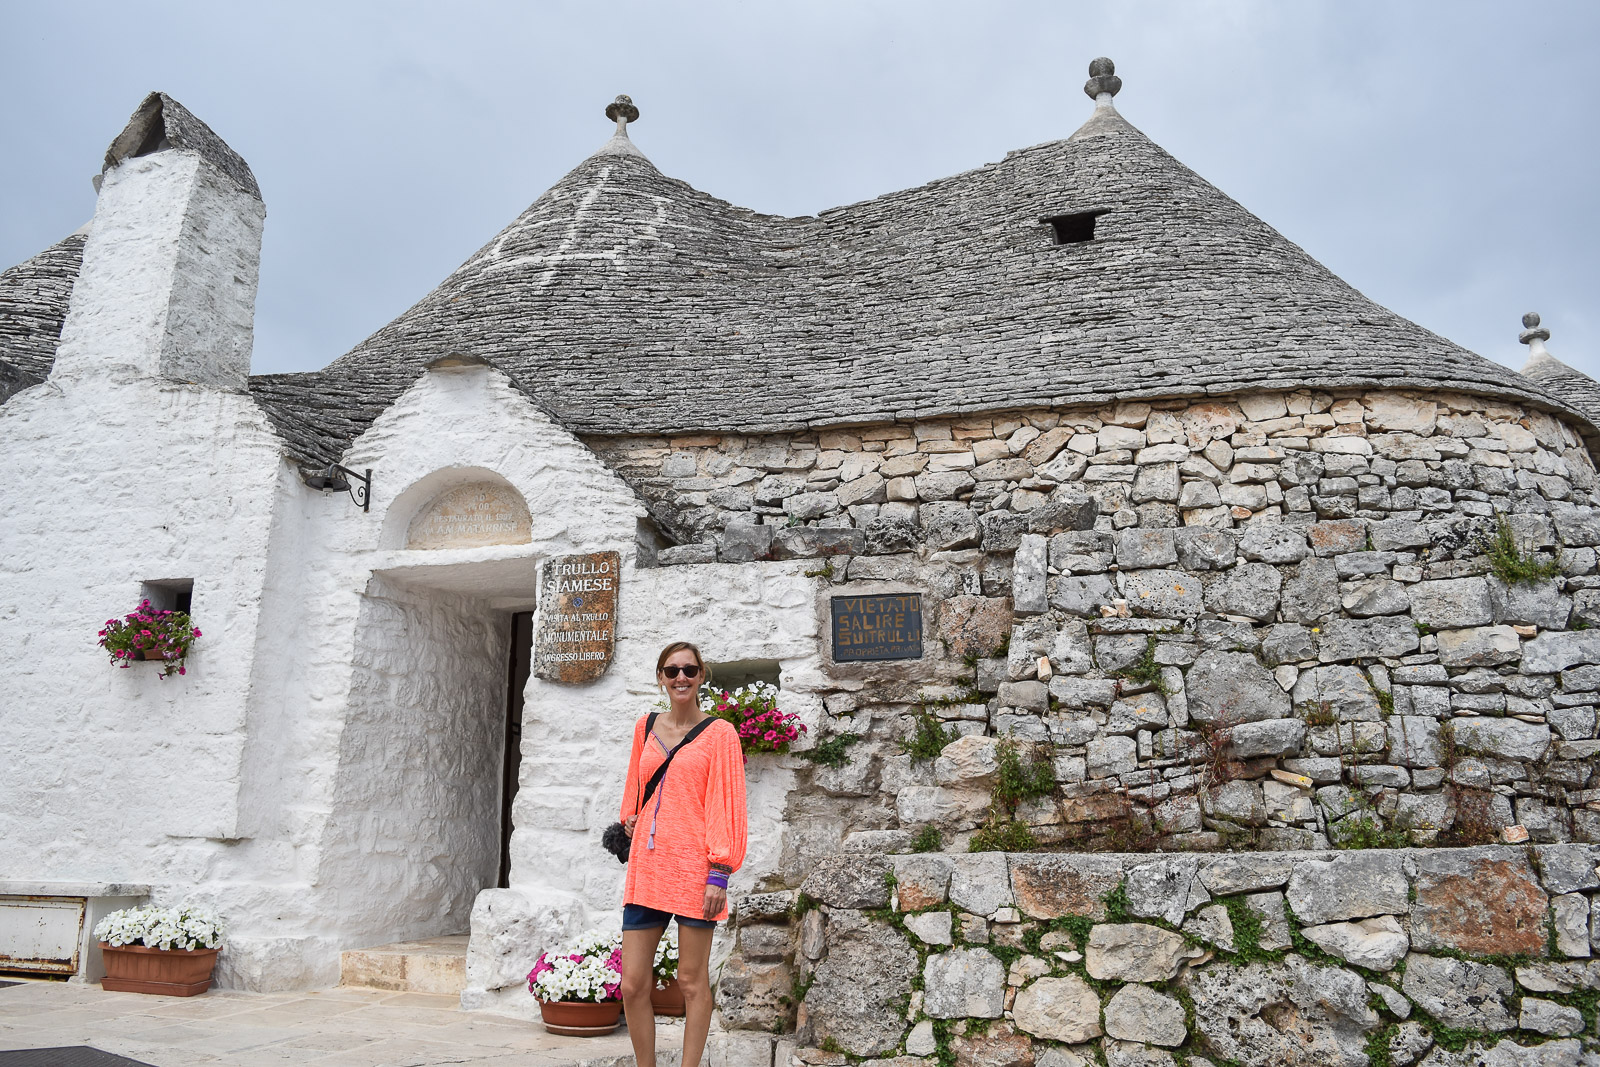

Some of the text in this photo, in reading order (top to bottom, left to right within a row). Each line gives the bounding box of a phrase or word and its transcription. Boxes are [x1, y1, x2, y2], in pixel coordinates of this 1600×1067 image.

[552, 562, 609, 576] TRULLO
[547, 578, 612, 593] SIAMESE
[844, 596, 919, 614] VIETATO
[546, 612, 609, 623] VISITA AL TRULLO
[838, 613, 905, 631] SALIRE
[544, 630, 608, 643] MONUMENTALE
[544, 652, 578, 662] INGRESSO
